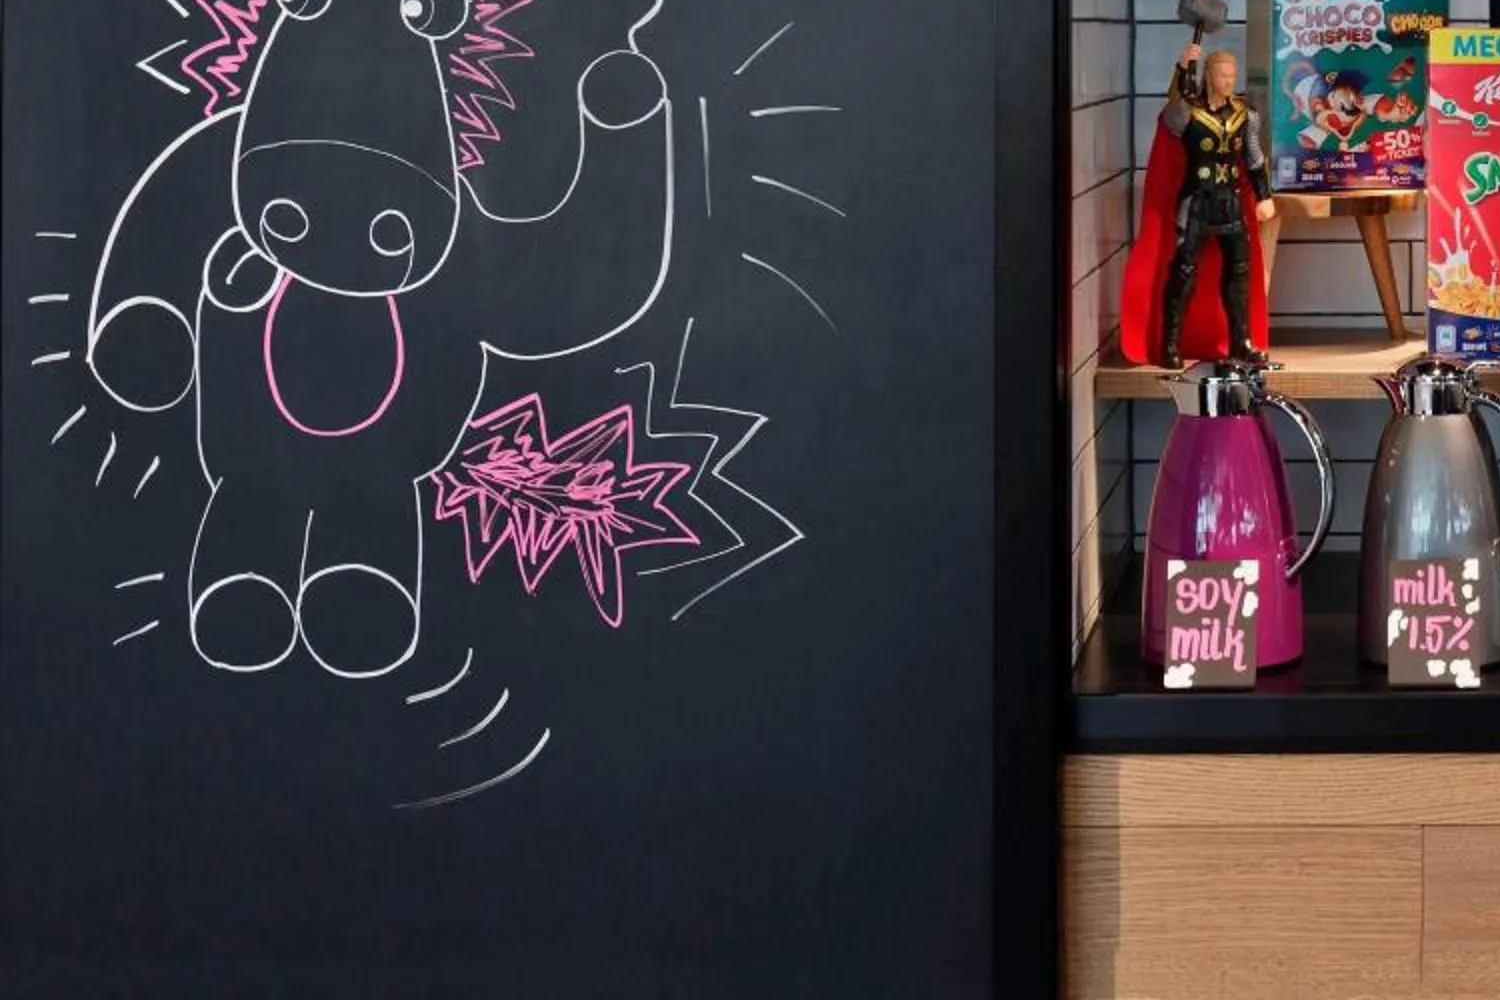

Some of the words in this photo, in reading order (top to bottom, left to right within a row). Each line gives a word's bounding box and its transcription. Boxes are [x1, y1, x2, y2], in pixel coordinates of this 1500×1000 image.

[1283, 3, 1382, 31] CHOCO
[1296, 28, 1373, 47] KRISPIES
[1176, 578, 1244, 627] soy
[1393, 563, 1456, 607] milk
[1170, 618, 1247, 672] milk
[1407, 615, 1474, 654] 1.5%
